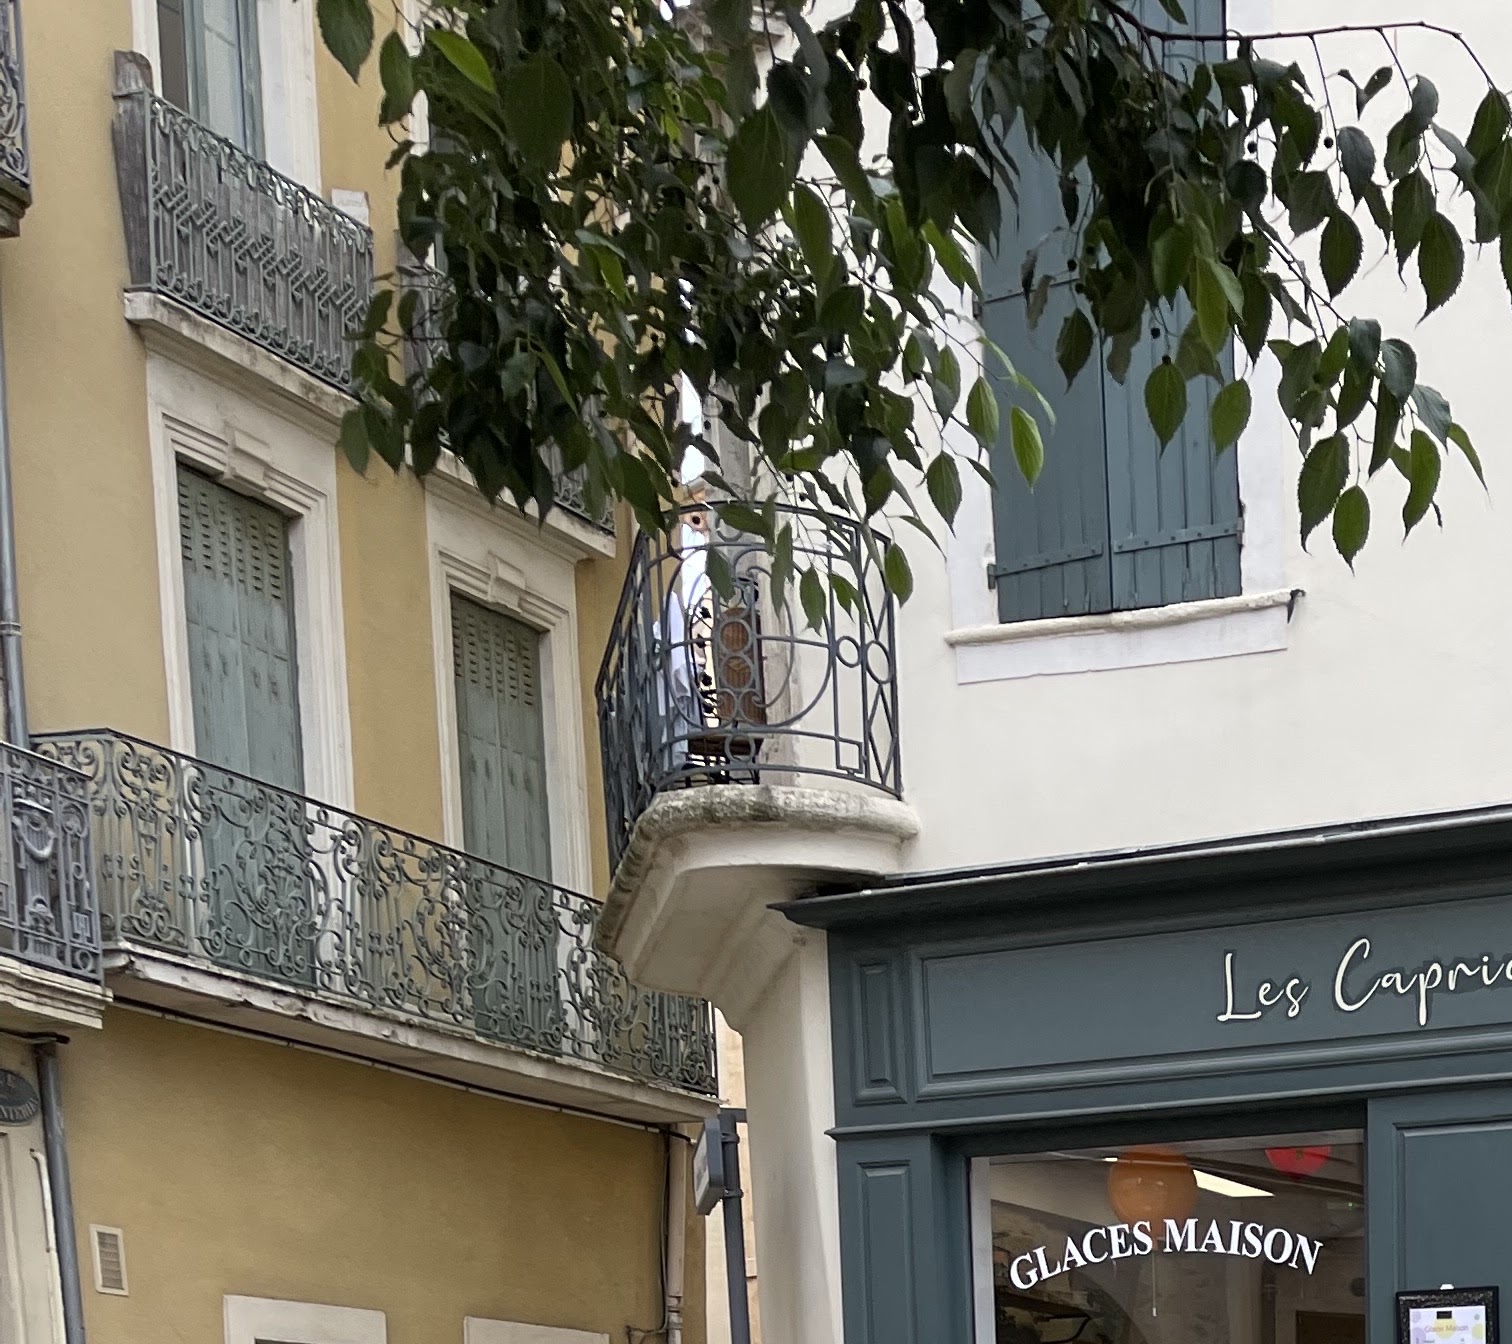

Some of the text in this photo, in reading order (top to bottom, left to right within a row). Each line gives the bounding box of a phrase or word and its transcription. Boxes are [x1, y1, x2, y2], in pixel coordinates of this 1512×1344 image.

[1217, 952, 1308, 1022] Les
[1009, 1218, 1324, 1291] GLACES MAISON
